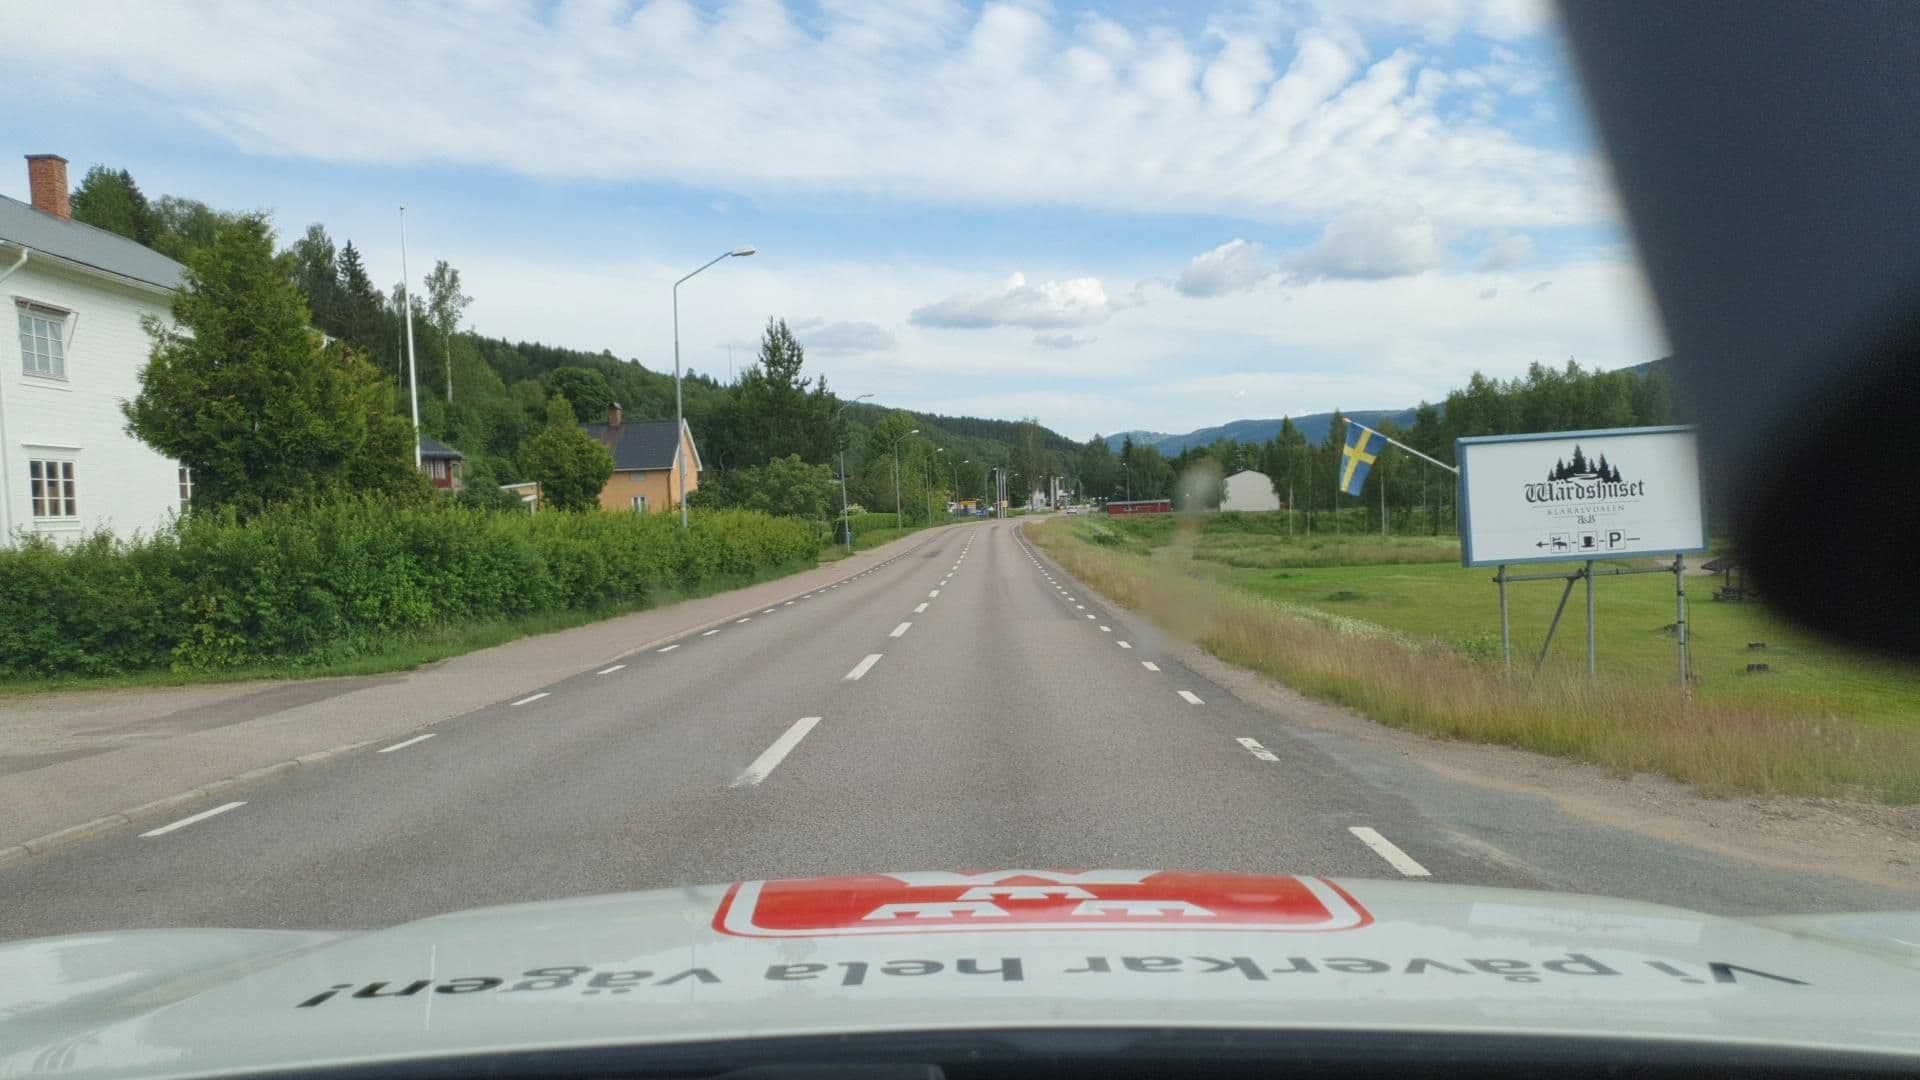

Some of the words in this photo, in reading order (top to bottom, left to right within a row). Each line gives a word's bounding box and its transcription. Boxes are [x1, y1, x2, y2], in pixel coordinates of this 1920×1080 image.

[1524, 480, 1645, 503] Wärdshuset
[1609, 532, 1622, 548] P
[764, 957, 1025, 986] hela
[1064, 953, 1623, 983] påverkar
[1645, 959, 1815, 987] Vi
[299, 965, 722, 1008] vägen!
